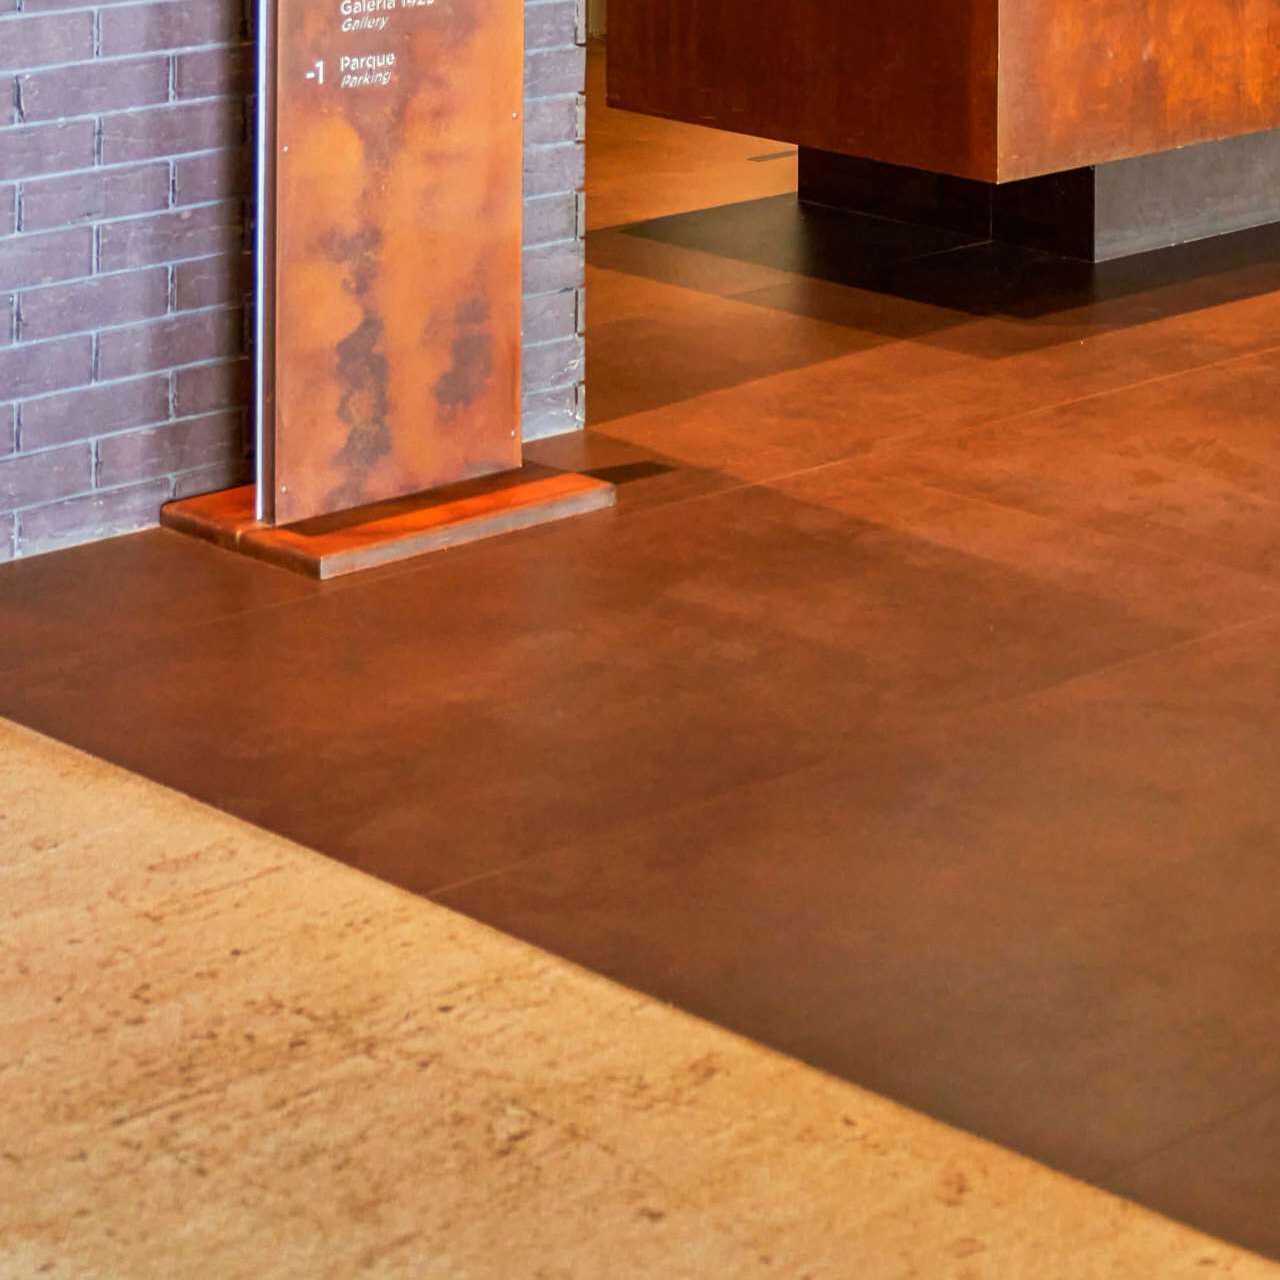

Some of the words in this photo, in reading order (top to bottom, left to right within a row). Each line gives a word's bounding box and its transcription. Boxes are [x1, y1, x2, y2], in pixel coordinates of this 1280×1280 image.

[341, 15, 389, 33] Gallery
[341, 51, 396, 71] Parque
[306, 61, 325, 85] -1
[341, 70, 391, 88] Parking
